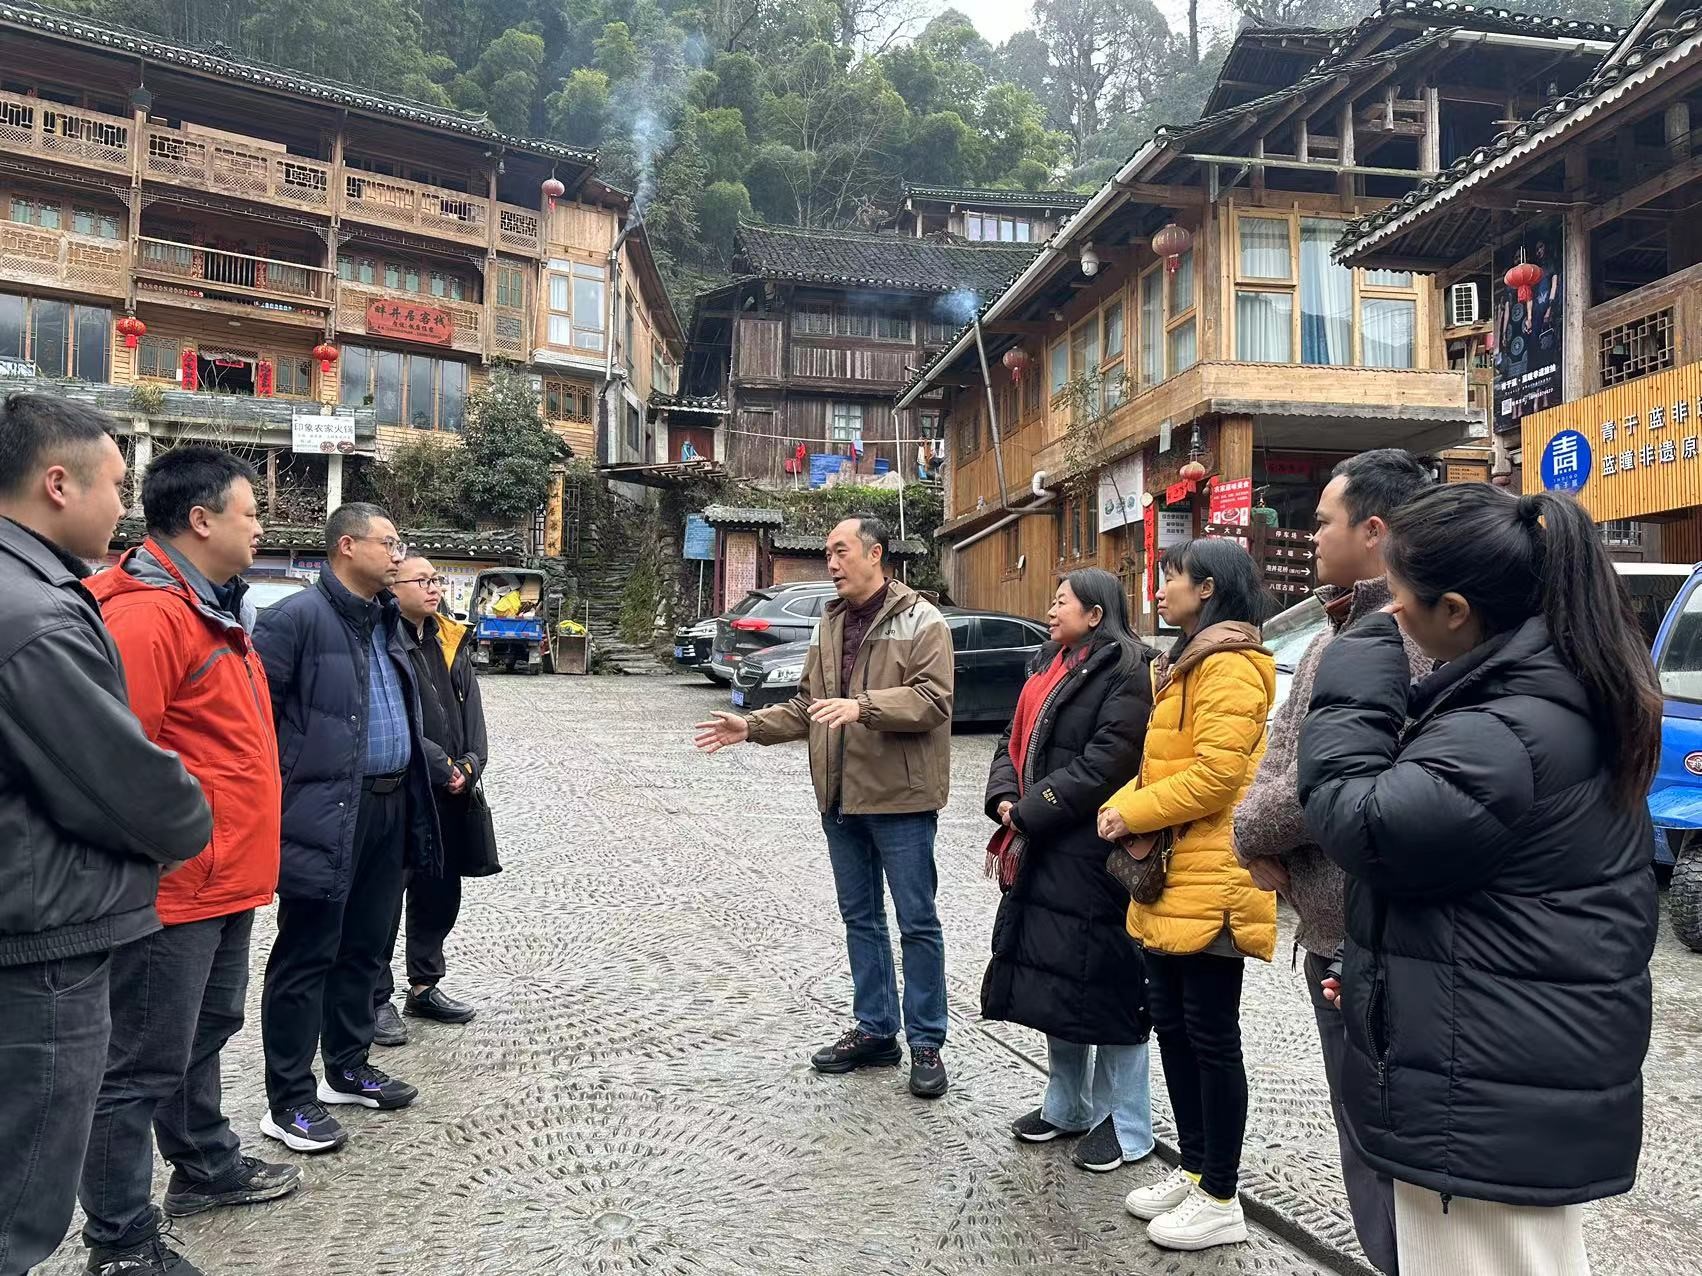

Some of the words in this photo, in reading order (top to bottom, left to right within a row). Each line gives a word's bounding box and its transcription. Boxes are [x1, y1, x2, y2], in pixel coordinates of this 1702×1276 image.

[294, 423, 353, 434] 印象农家火锅
[1601, 394, 1702, 443] 青于蓝非
[1602, 436, 1698, 476] 蓝瞳非遗原
[1275, 530, 1297, 540] 停车场
